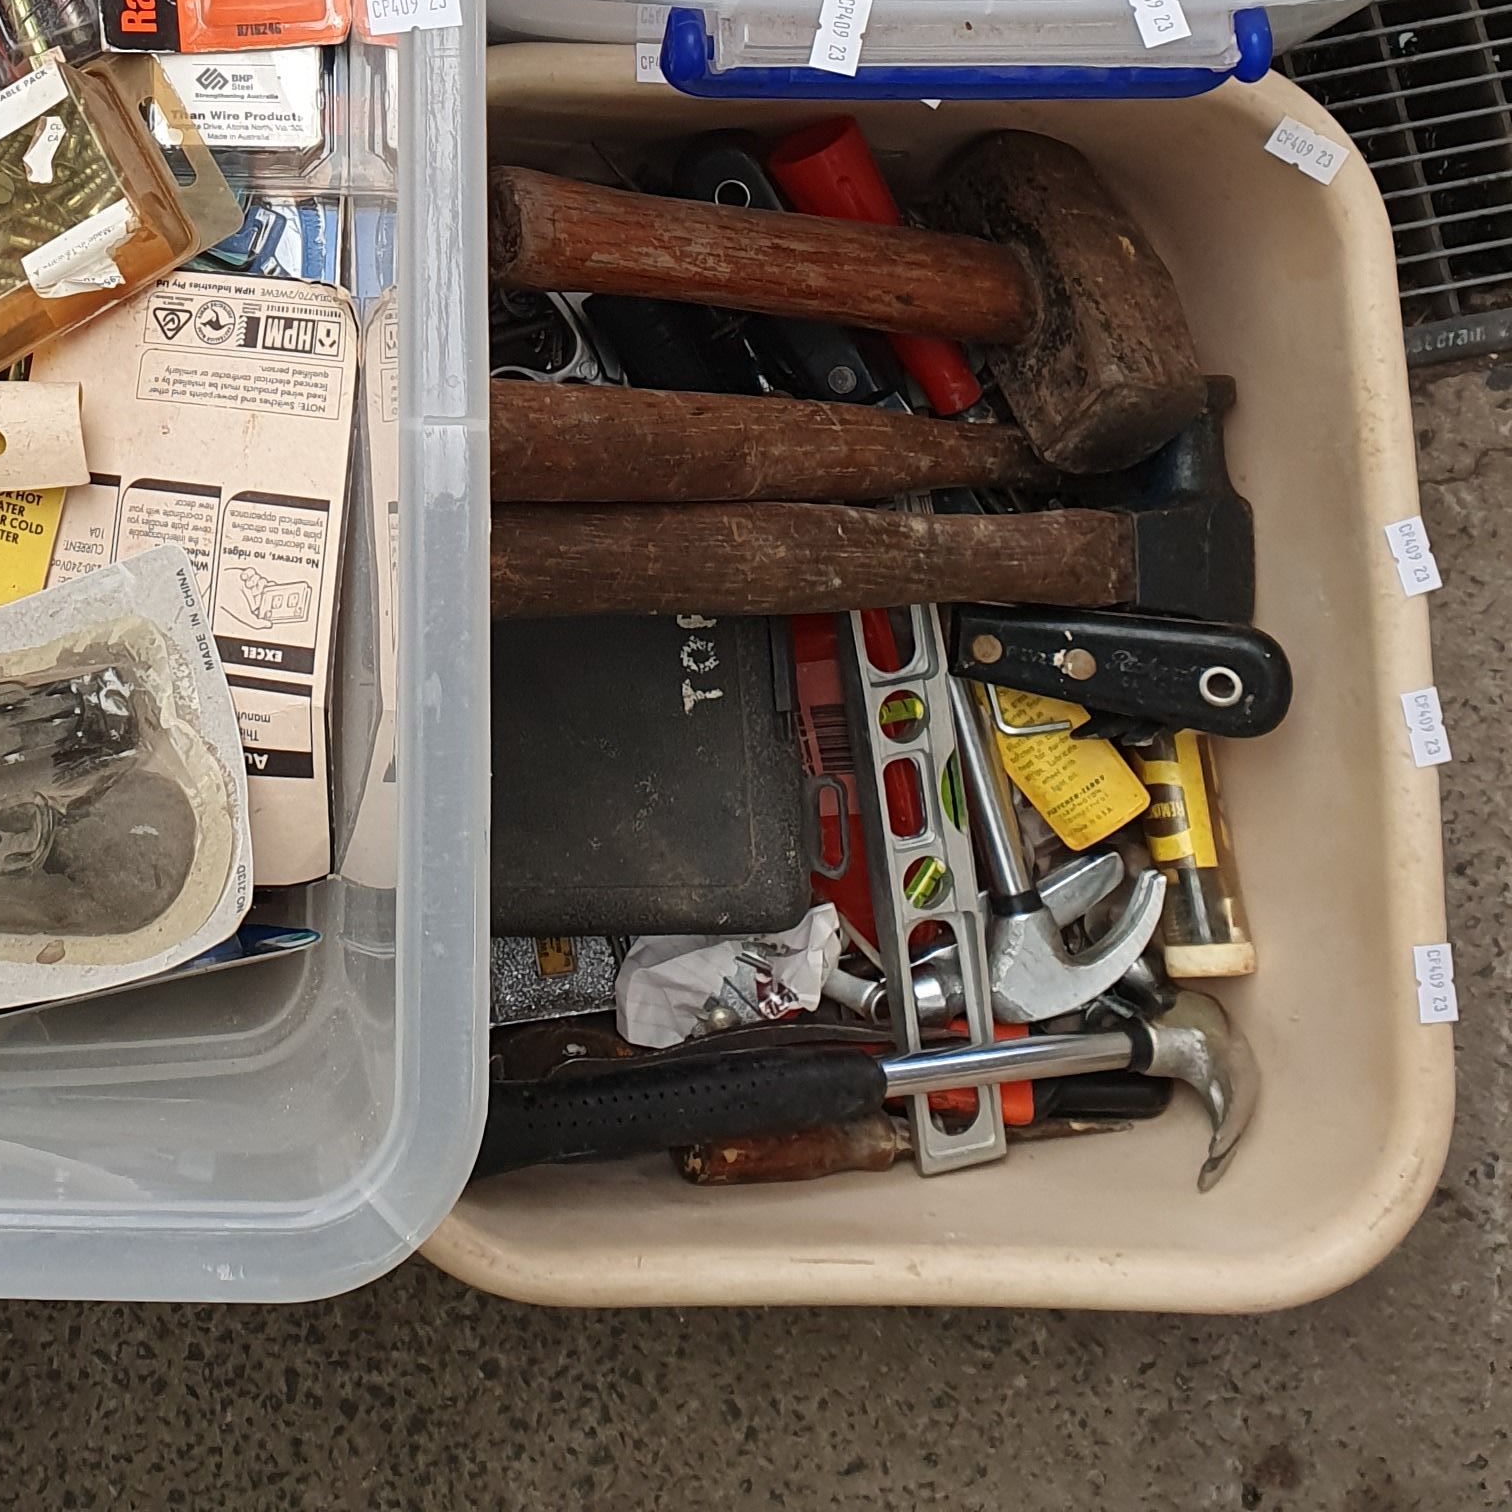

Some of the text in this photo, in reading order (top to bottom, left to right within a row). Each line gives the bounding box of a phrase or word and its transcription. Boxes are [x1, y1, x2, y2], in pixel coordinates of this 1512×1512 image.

[1153, 14, 1174, 32] 23
[828, 45, 846, 62] 23
[21, 69, 49, 90] PACK
[231, 74, 253, 82] BHP
[210, 111, 240, 120] Wire
[1276, 129, 1334, 168] CP409 23
[156, 279, 256, 295] HPM Industries Pty Ltd
[265, 317, 313, 351] HPM
[259, 365, 289, 376] person.
[254, 375, 291, 386] electrical
[298, 401, 326, 413] NOTE:
[15, 491, 43, 506] HOT
[9, 517, 44, 536] COLD
[223, 547, 320, 568] No screws, no ridges
[1399, 523, 1430, 583] CP409 23
[176, 567, 215, 671] MADE IN CHINA
[241, 645, 283, 663] EXCEL
[1414, 694, 1441, 755] CP409 23
[235, 863, 248, 914] NO.213D
[1427, 949, 1449, 1012] CP409 23
